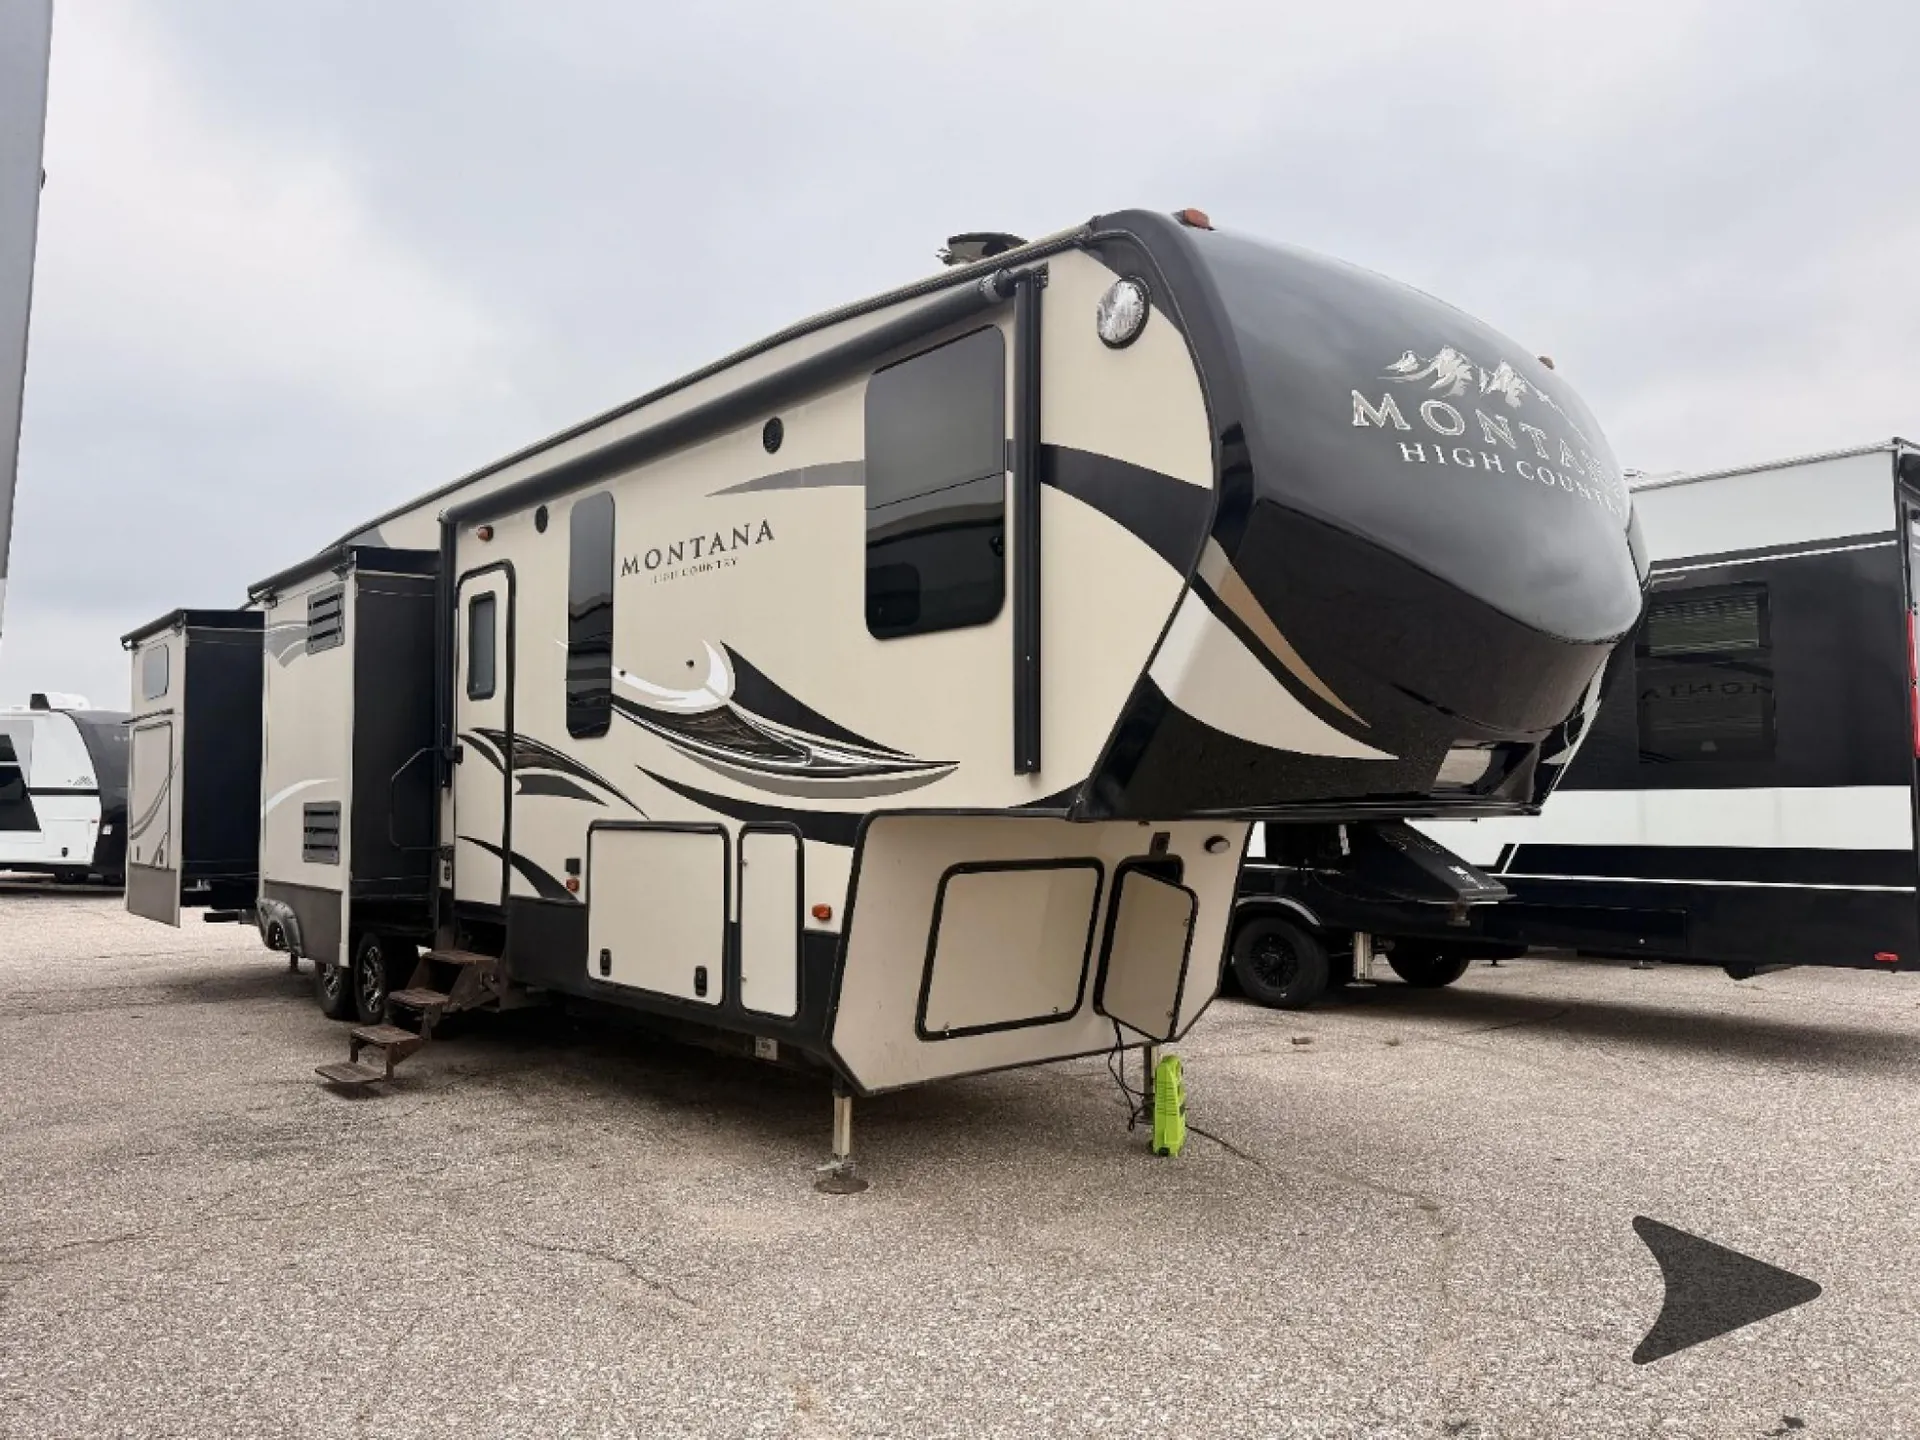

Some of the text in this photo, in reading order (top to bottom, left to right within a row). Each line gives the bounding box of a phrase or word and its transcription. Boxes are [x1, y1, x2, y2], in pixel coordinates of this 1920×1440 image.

[1398, 442, 1505, 473] HIGH
[621, 518, 774, 577] MONTANA
[682, 557, 738, 577] COUNTRY
